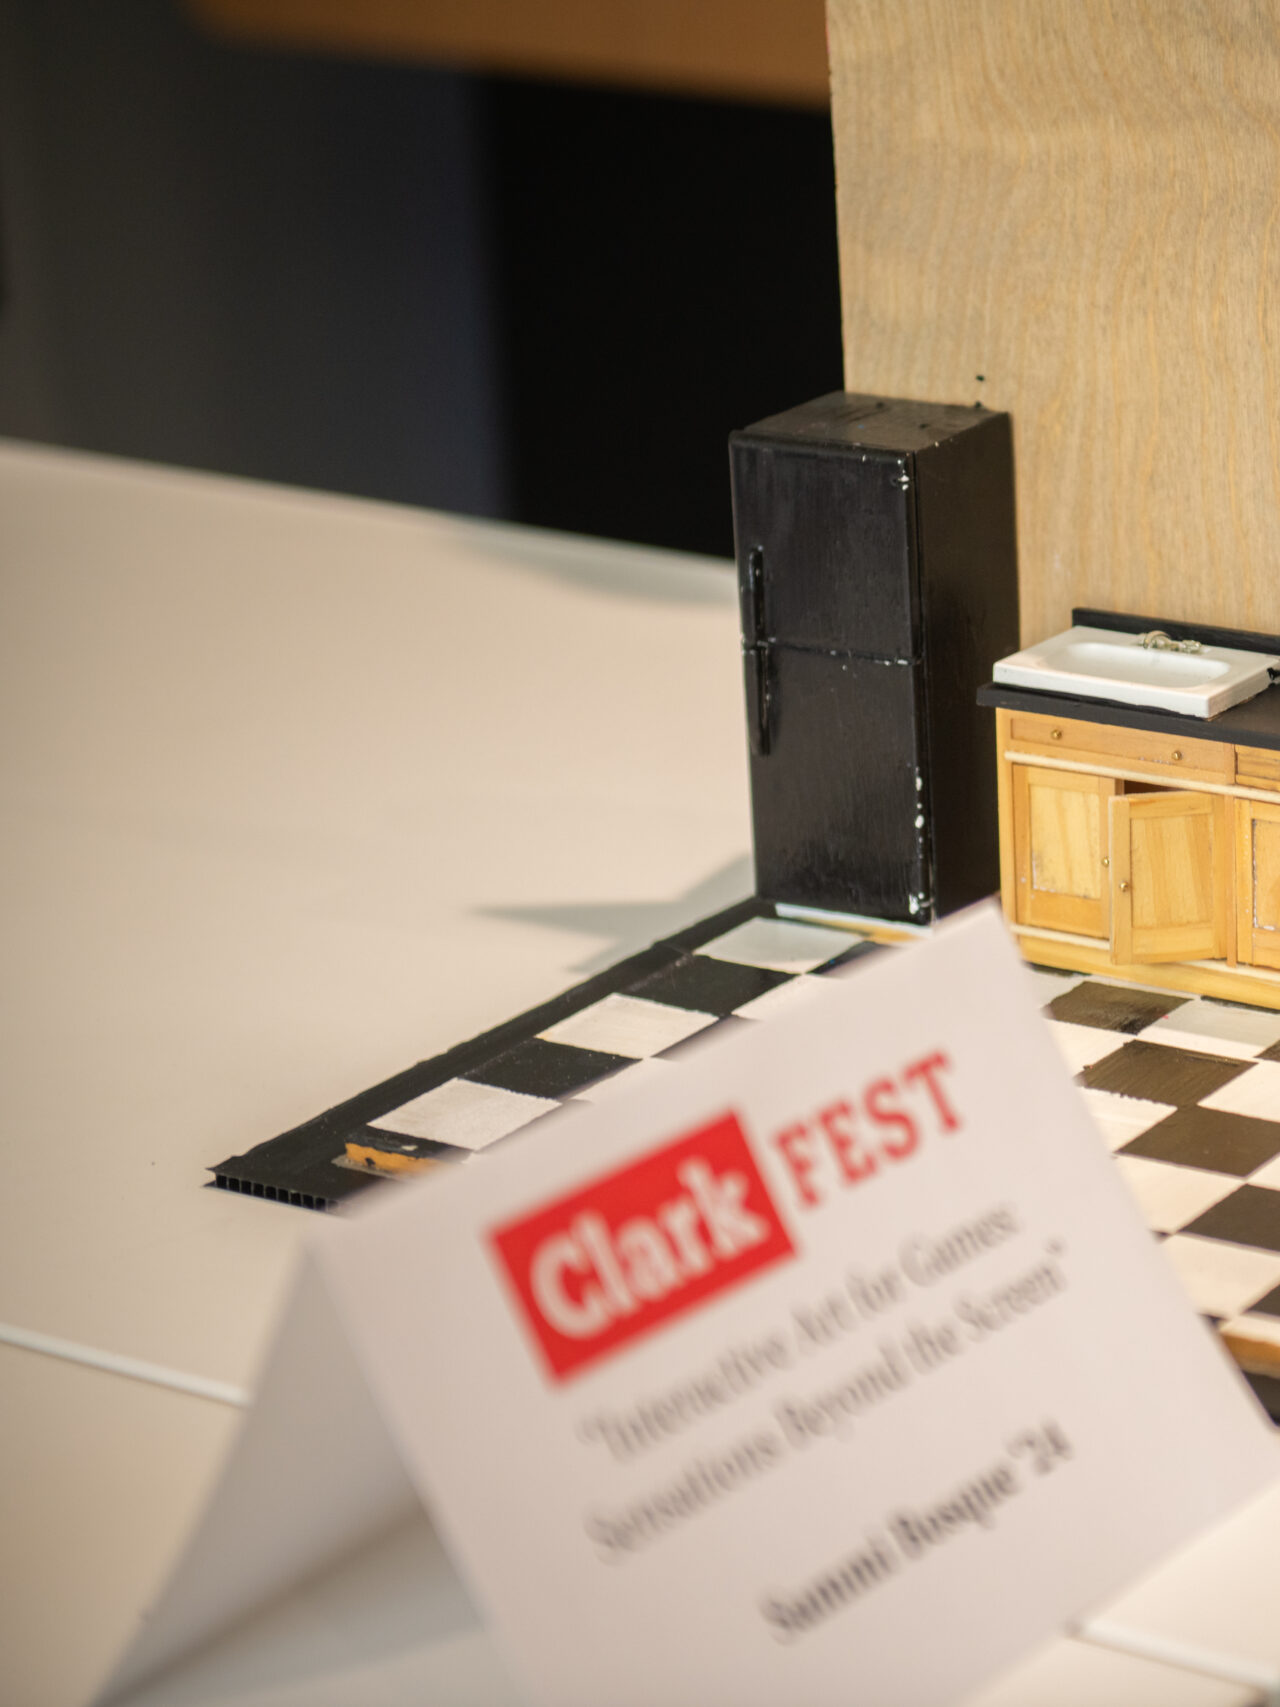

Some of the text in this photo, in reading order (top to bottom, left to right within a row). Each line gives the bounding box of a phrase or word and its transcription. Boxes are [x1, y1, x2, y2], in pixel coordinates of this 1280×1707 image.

[534, 1051, 961, 1336] Clark FEST
[794, 1292, 854, 1352] Art
[846, 1264, 903, 1320] for
[585, 1431, 782, 1564] Sensations
[774, 1340, 908, 1450] Beyond
[905, 1317, 963, 1374] the
